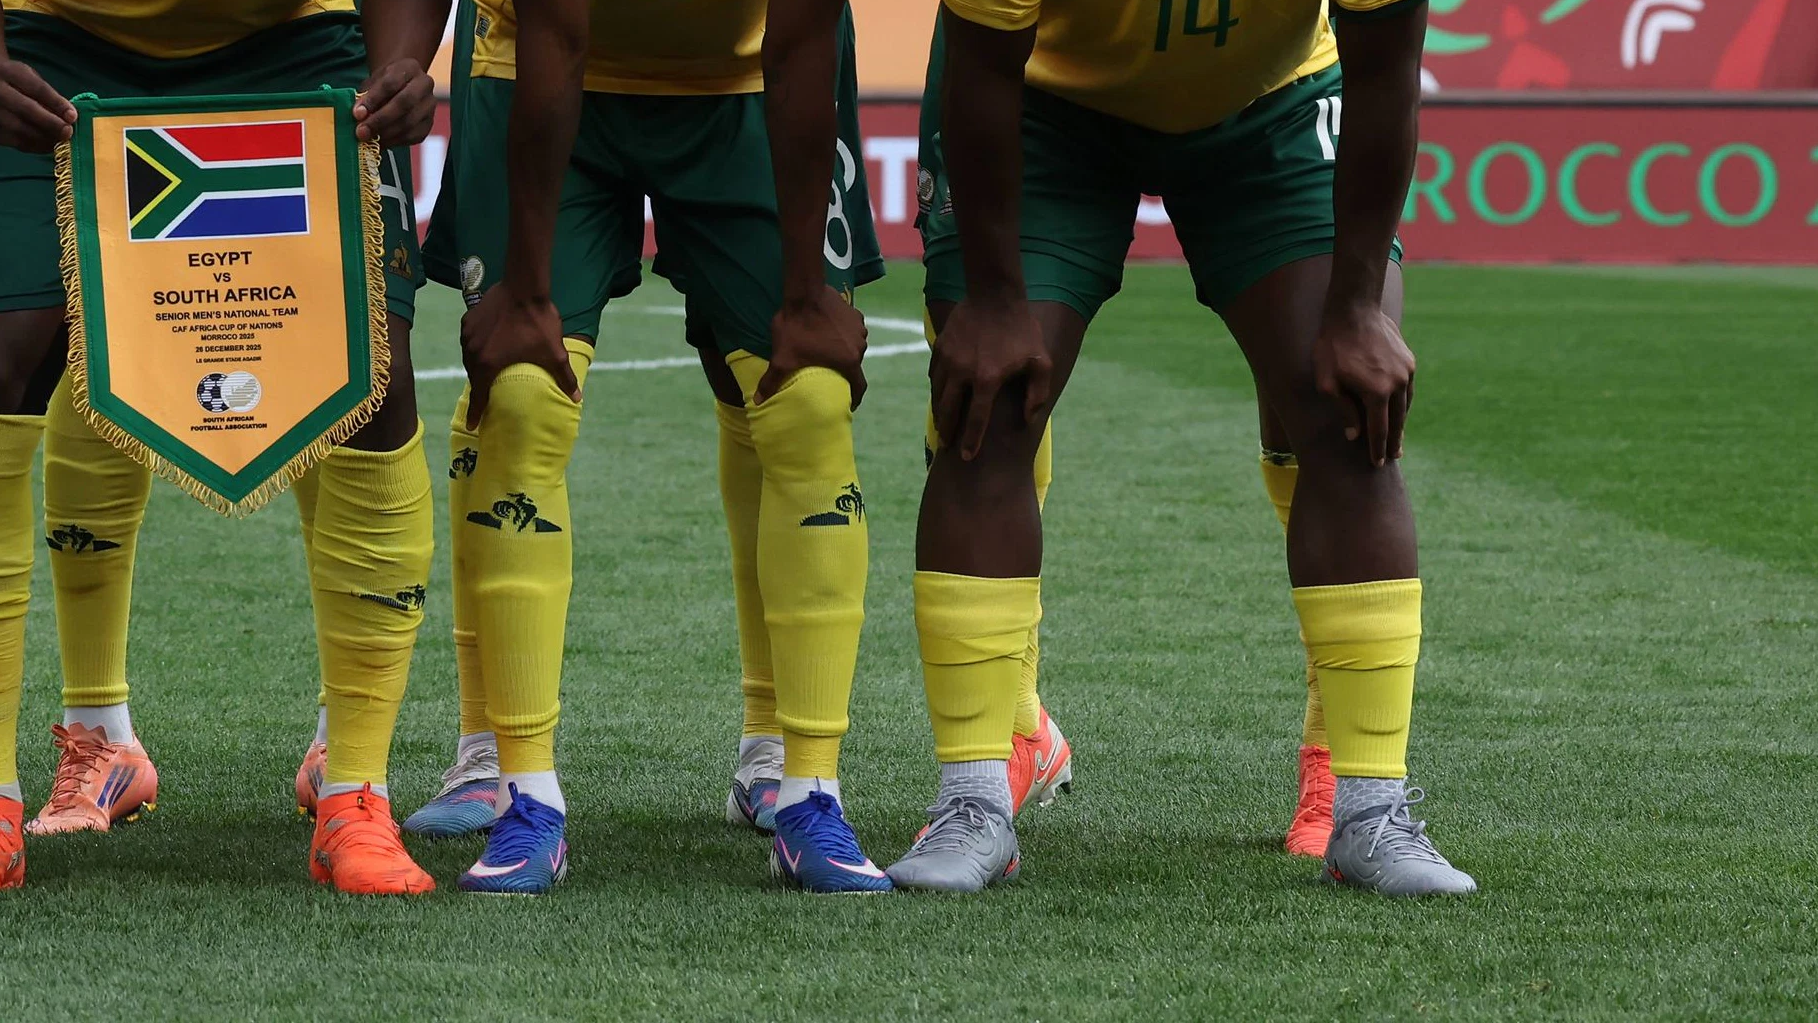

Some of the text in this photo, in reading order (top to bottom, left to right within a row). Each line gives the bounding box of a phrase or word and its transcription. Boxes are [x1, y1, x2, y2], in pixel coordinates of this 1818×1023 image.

[188, 251, 252, 267] EGYPT
[213, 272, 231, 282] VS
[153, 286, 296, 305] SOUTH AFRICA
[156, 307, 298, 321] SENIOR MEN'S NATIONAL TEAM
